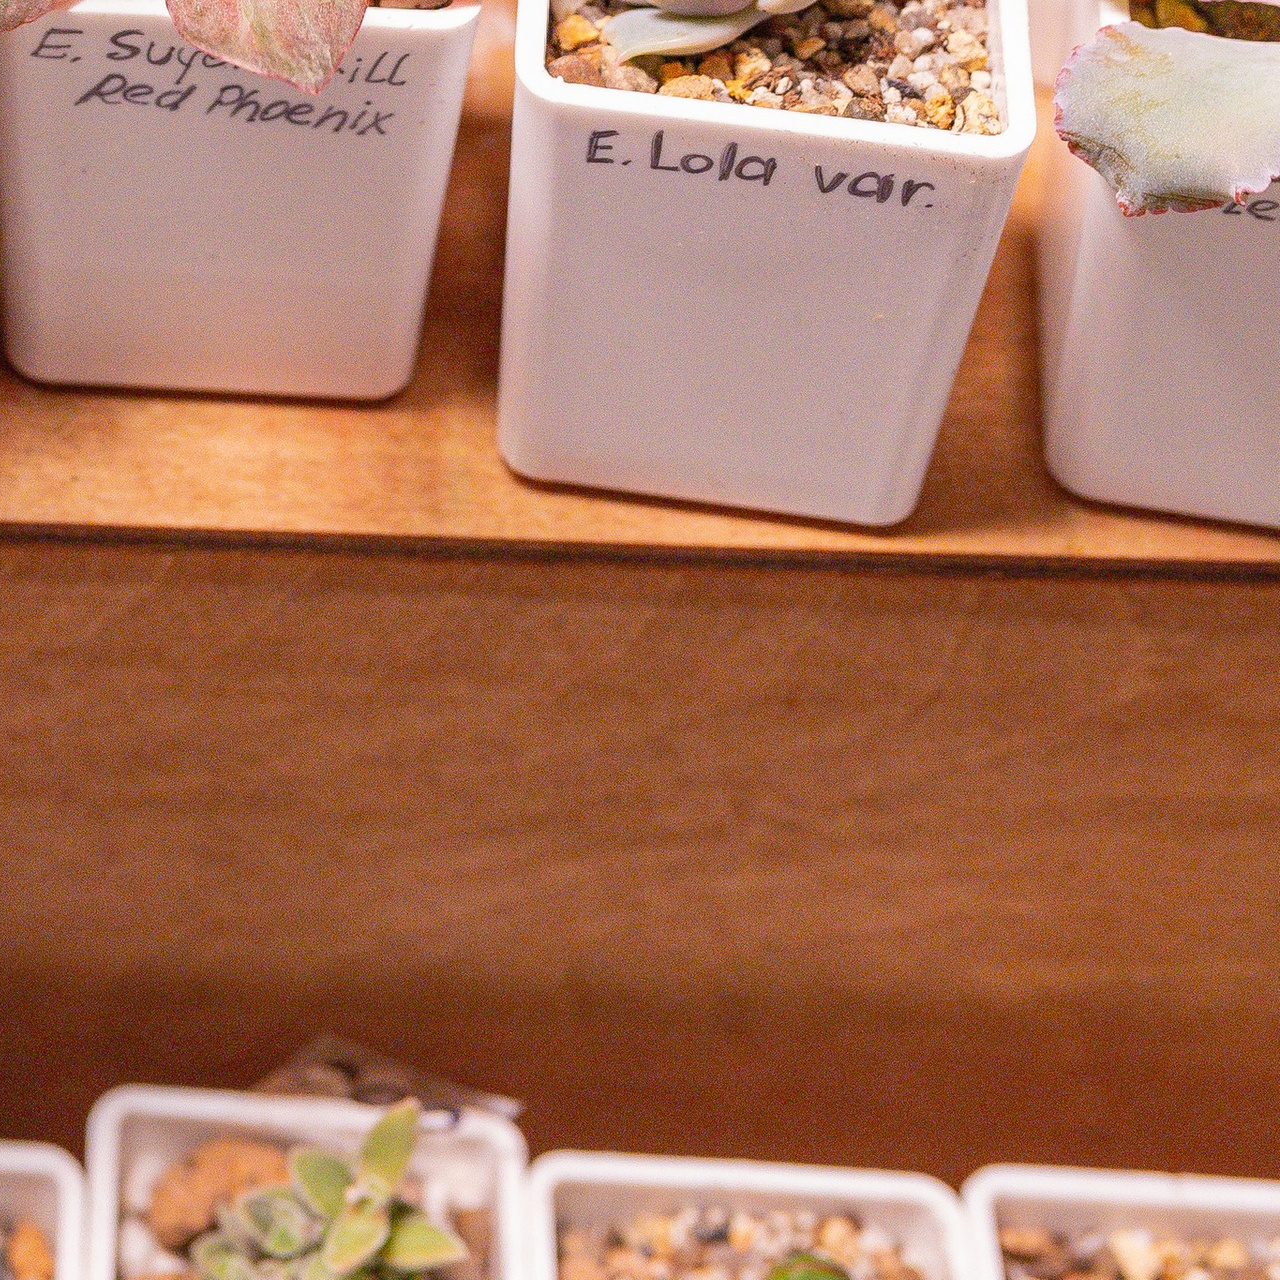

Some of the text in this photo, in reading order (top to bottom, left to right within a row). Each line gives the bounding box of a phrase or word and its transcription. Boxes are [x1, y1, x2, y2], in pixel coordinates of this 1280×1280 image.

[30, 28, 84, 64] E.
[75, 73, 396, 136] Red Phoenix
[586, 130, 936, 208] E. Lola var.
